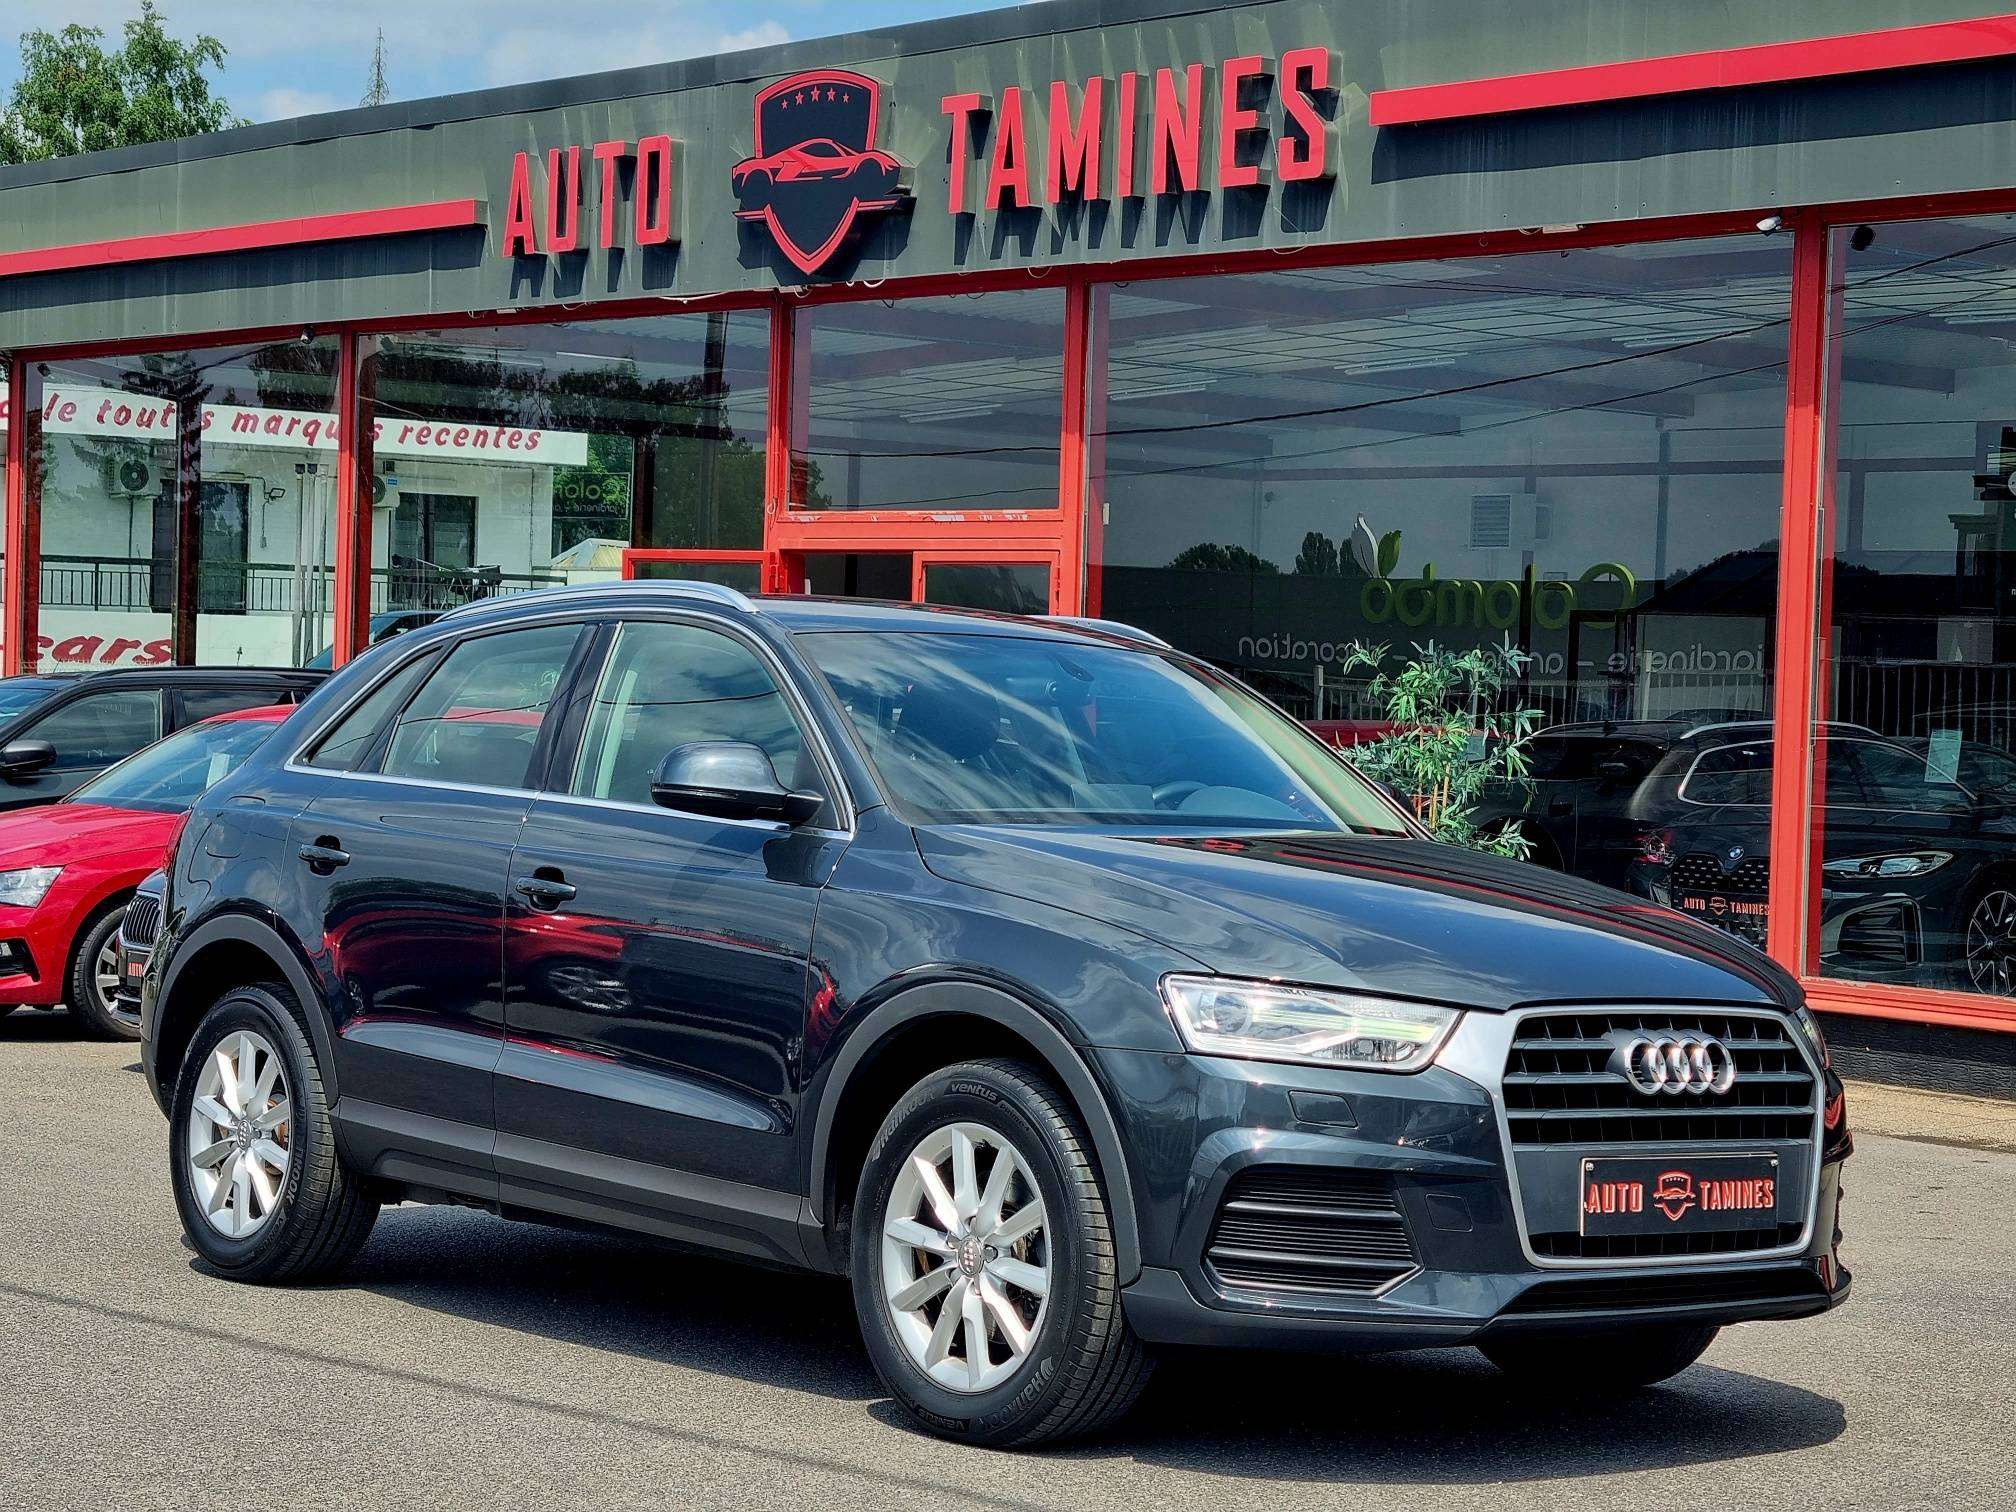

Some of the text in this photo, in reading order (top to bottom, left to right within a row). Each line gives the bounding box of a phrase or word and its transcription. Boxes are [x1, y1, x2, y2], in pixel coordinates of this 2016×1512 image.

[502, 46, 1334, 257] AUTO TAMINES
[97, 399, 215, 431] touts
[231, 411, 384, 447] marqus
[1683, 897, 1706, 911] AUTO
[1585, 1179, 1774, 1214] AUTO TAMINES
